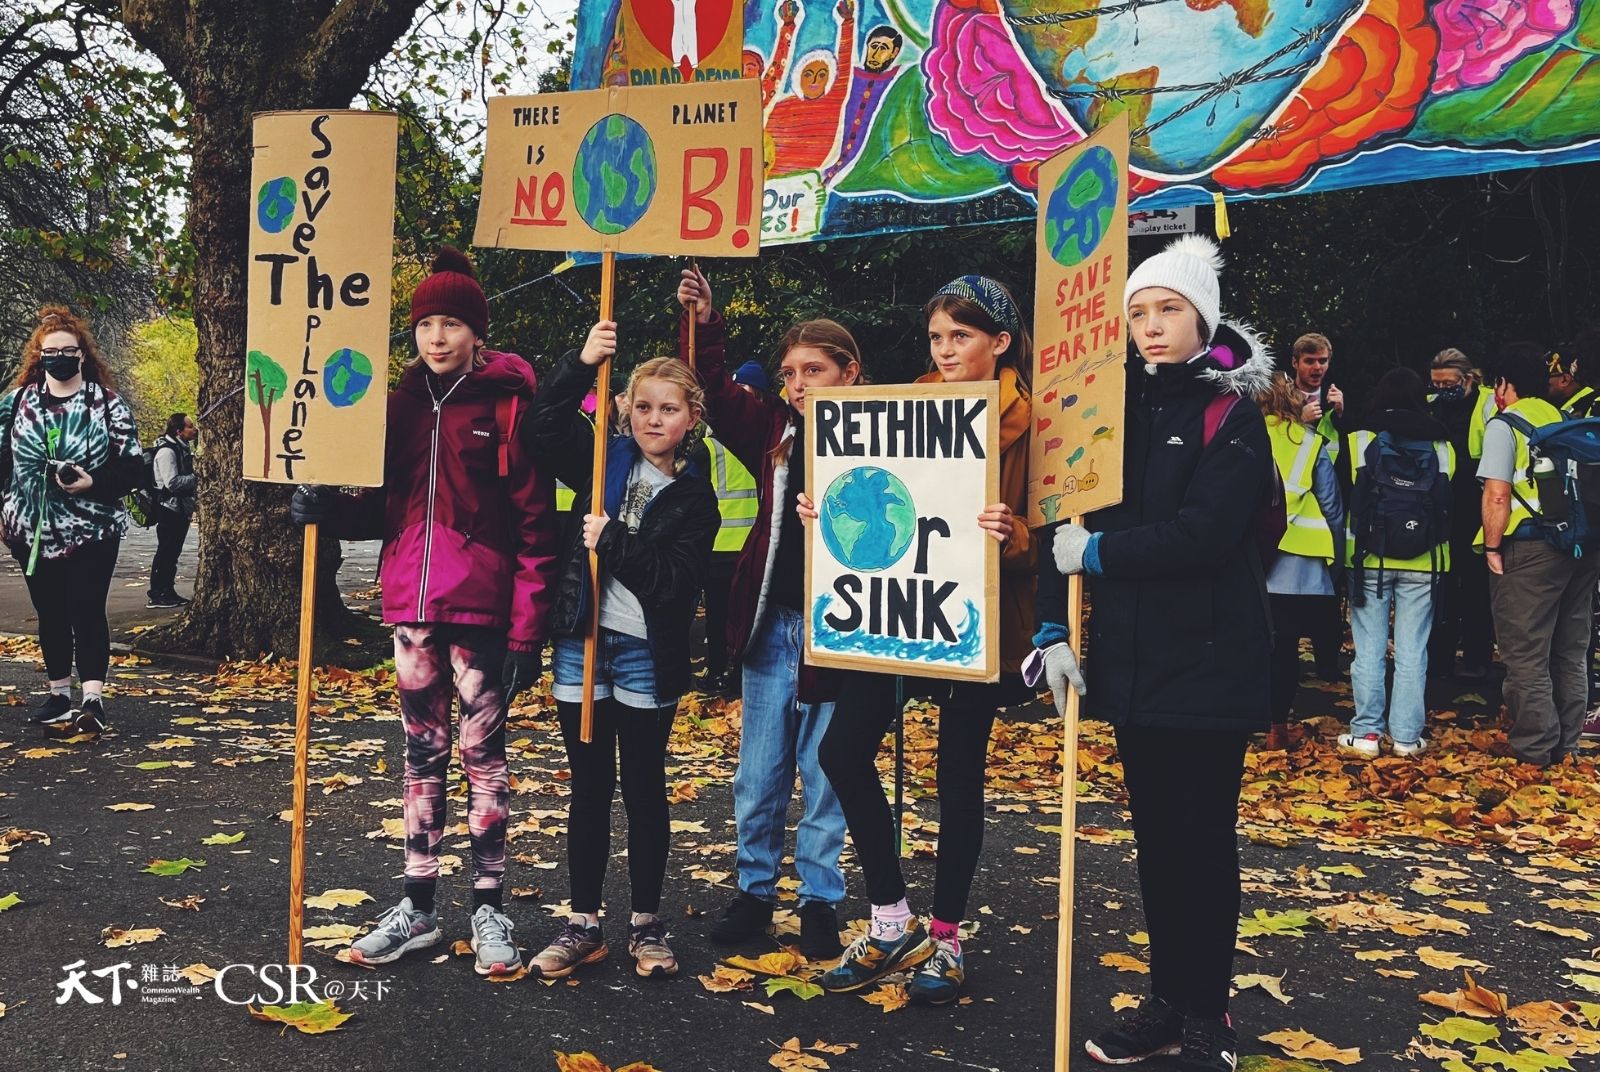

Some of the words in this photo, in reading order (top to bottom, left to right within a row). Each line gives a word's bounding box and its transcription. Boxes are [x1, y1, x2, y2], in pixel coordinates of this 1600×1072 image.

[513, 106, 560, 127] THERE
[672, 101, 738, 124] PLANET
[527, 145, 545, 165] IS
[514, 171, 566, 221] NO
[680, 147, 754, 249] B!
[1163, 223, 1186, 231] ticket
[254, 252, 371, 311] The
[1055, 254, 1112, 307] SAVE
[1060, 290, 1106, 333] THE
[1039, 315, 1120, 375] EARTH
[815, 398, 988, 460] RETHINK
[1064, 479, 1075, 492] HI
[824, 573, 960, 643] SINK
